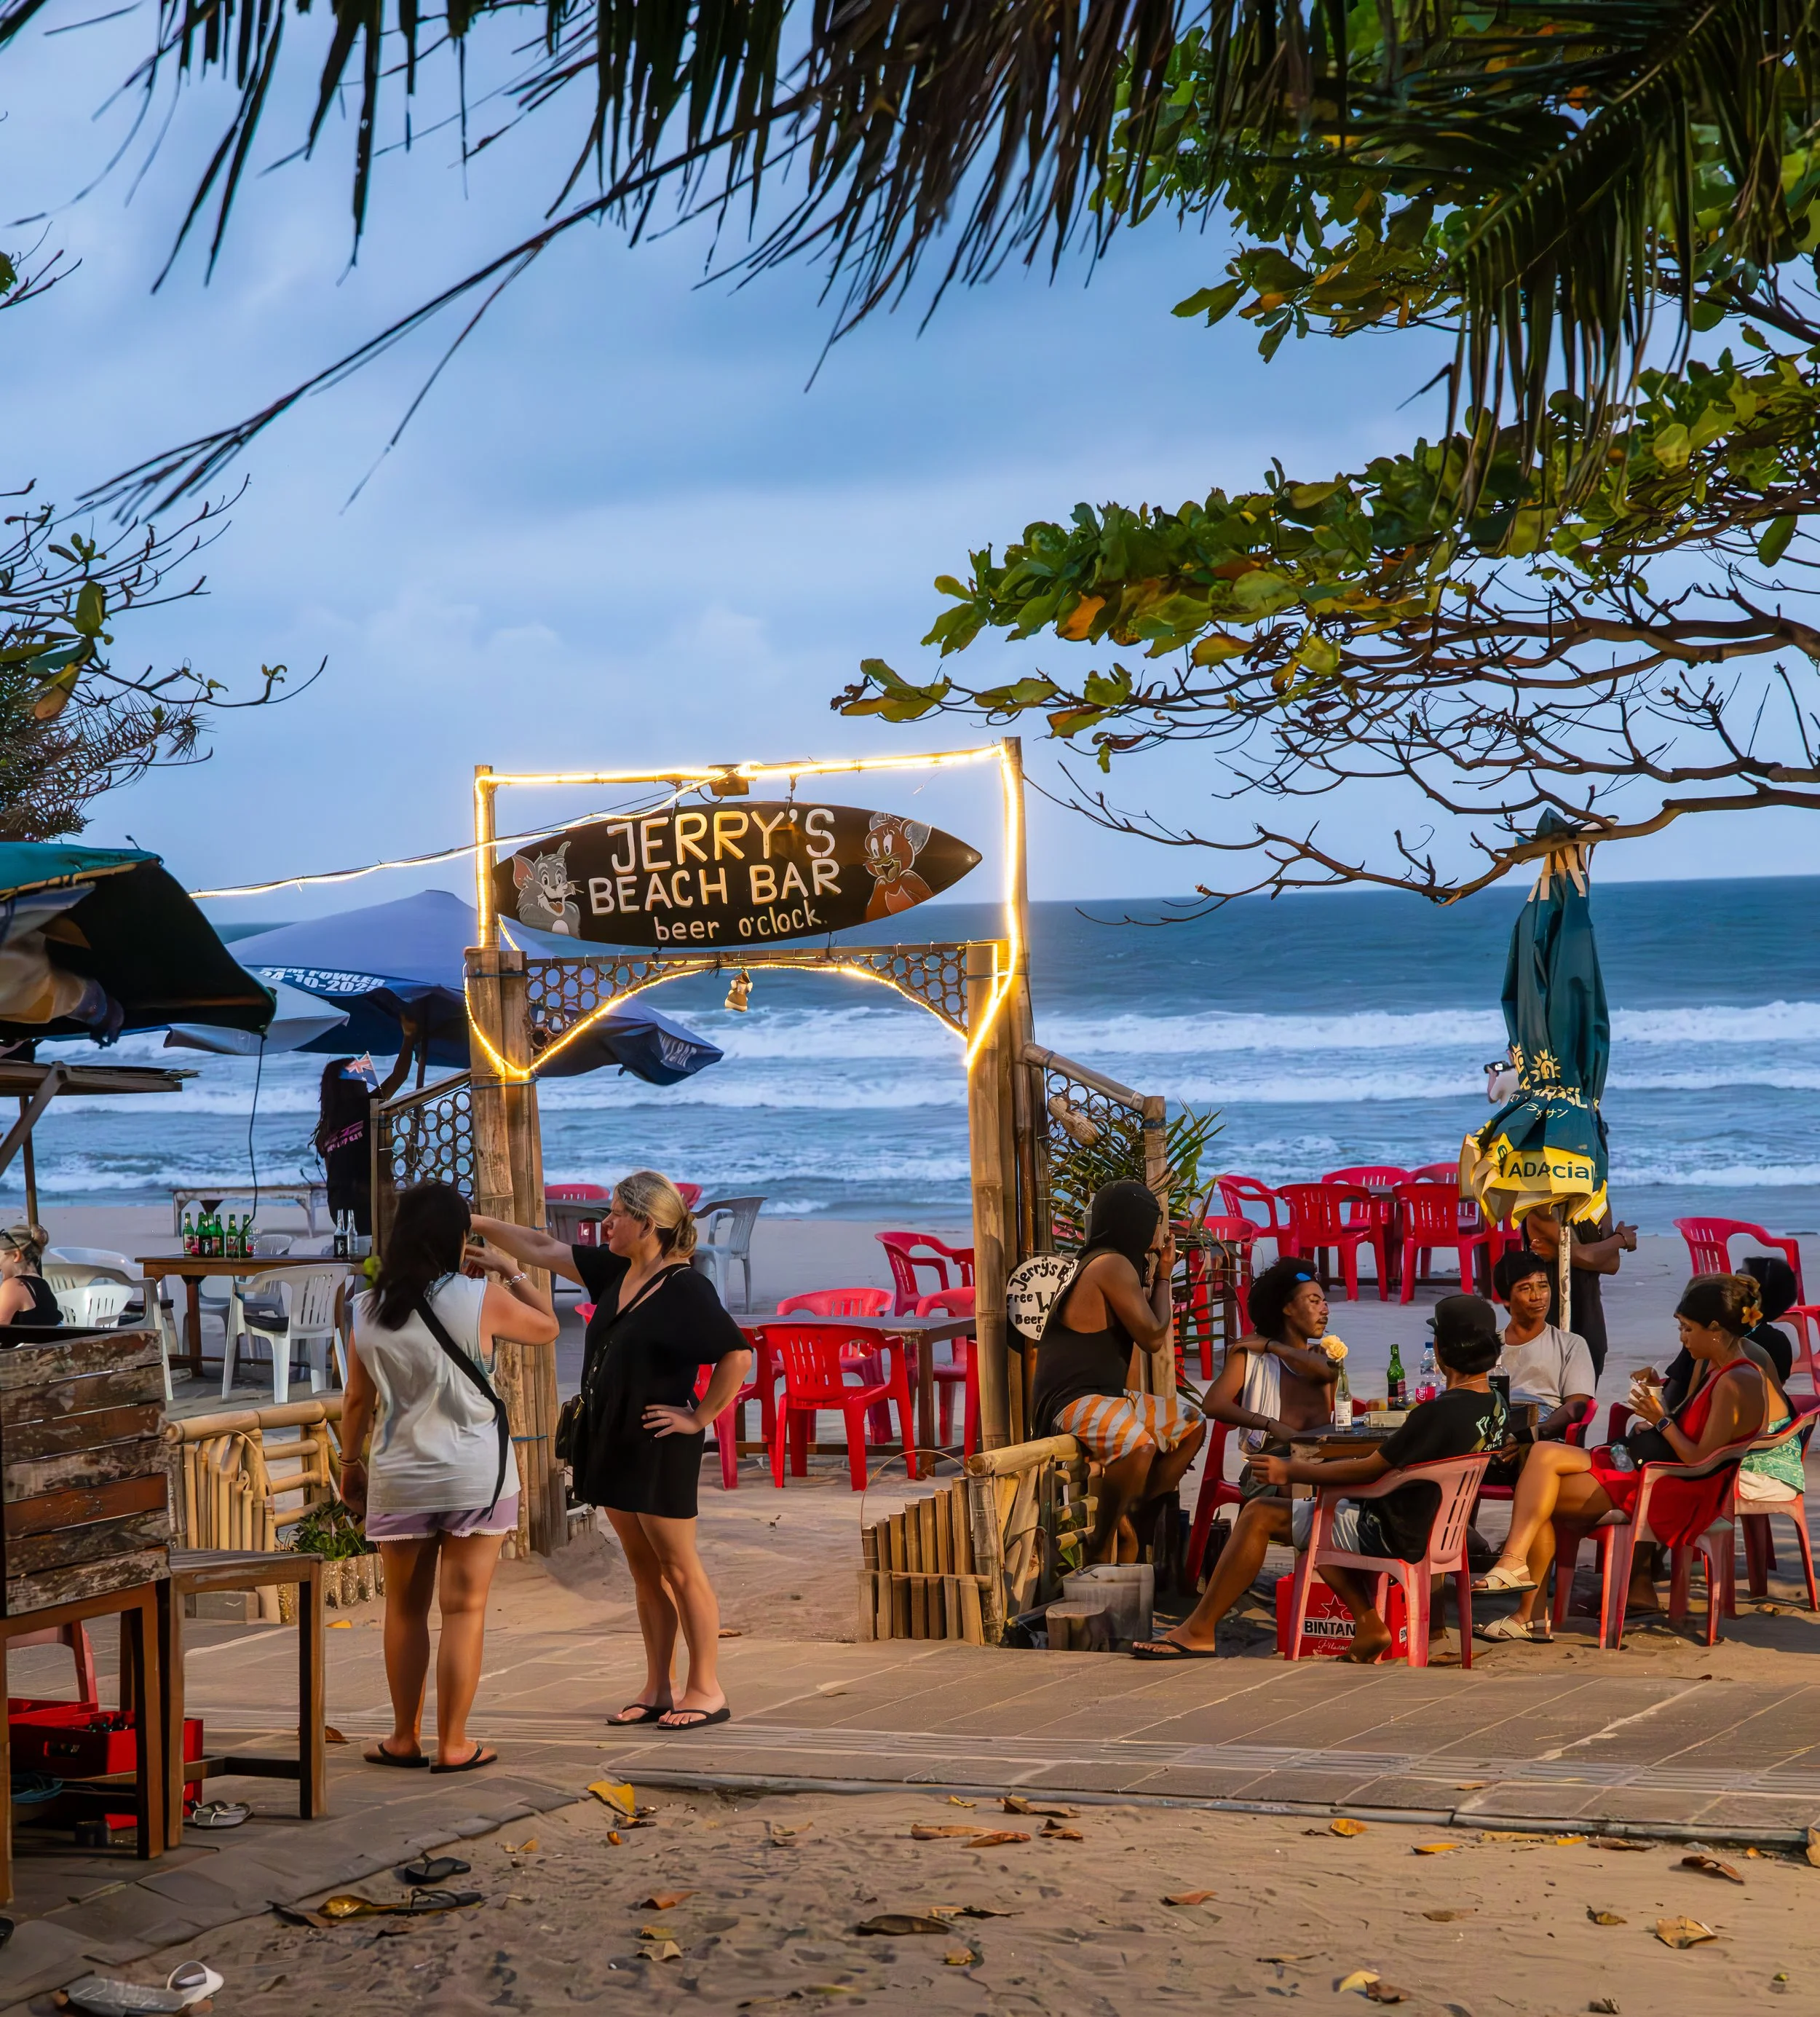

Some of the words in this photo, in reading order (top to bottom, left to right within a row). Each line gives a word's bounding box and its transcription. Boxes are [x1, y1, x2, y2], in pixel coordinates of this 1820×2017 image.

[607, 808, 836, 874] JERRY'S
[589, 868, 728, 917] BEACH
[749, 858, 842, 905] BAR
[654, 917, 719, 941] beer
[1010, 1261, 1059, 1292] Jerry's
[1007, 1293, 1033, 1303] Free
[1015, 1314, 1043, 1325] Beer
[1305, 1621, 1356, 1637] BINTAN
